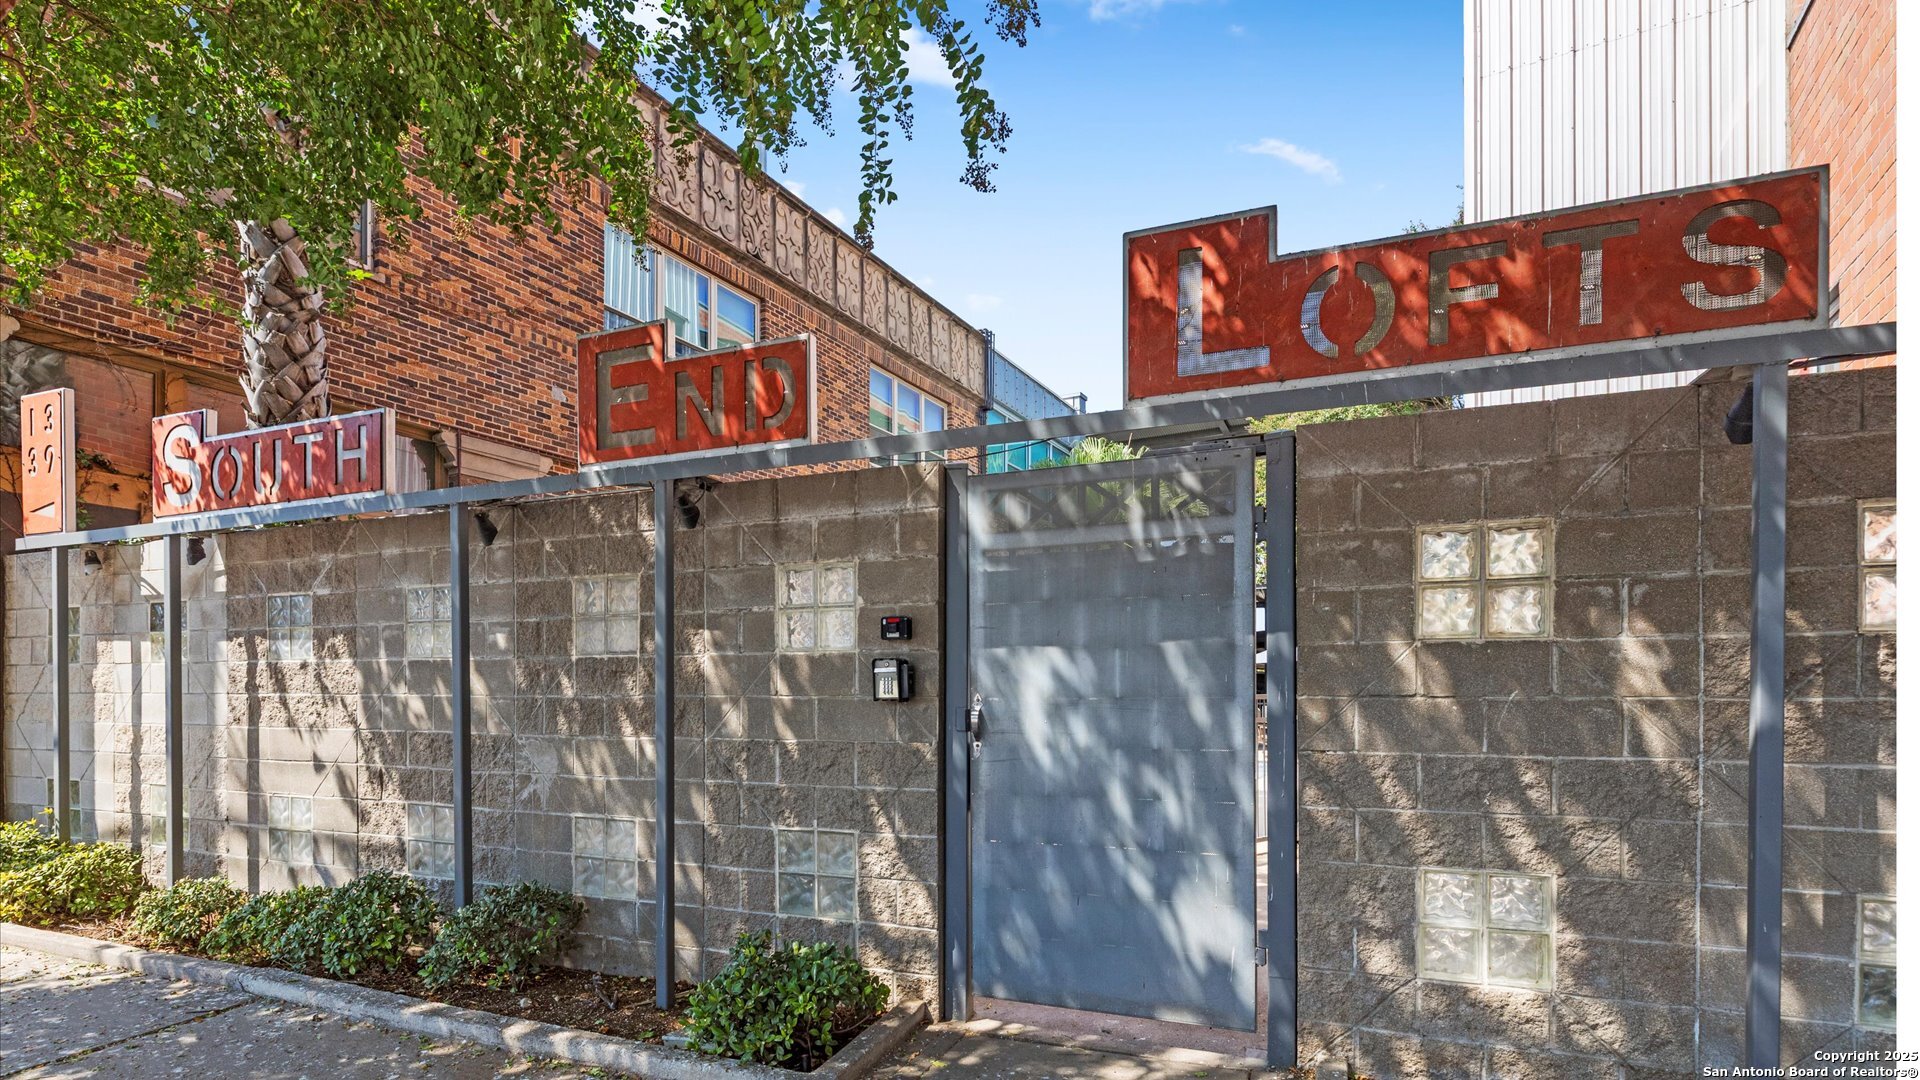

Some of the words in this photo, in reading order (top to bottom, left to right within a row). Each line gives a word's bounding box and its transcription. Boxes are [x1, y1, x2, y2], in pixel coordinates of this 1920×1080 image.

[1177, 199, 1789, 377] LOFTS
[596, 343, 796, 450] END
[28, 444, 56, 478] 39
[162, 423, 367, 507] SOUTH
